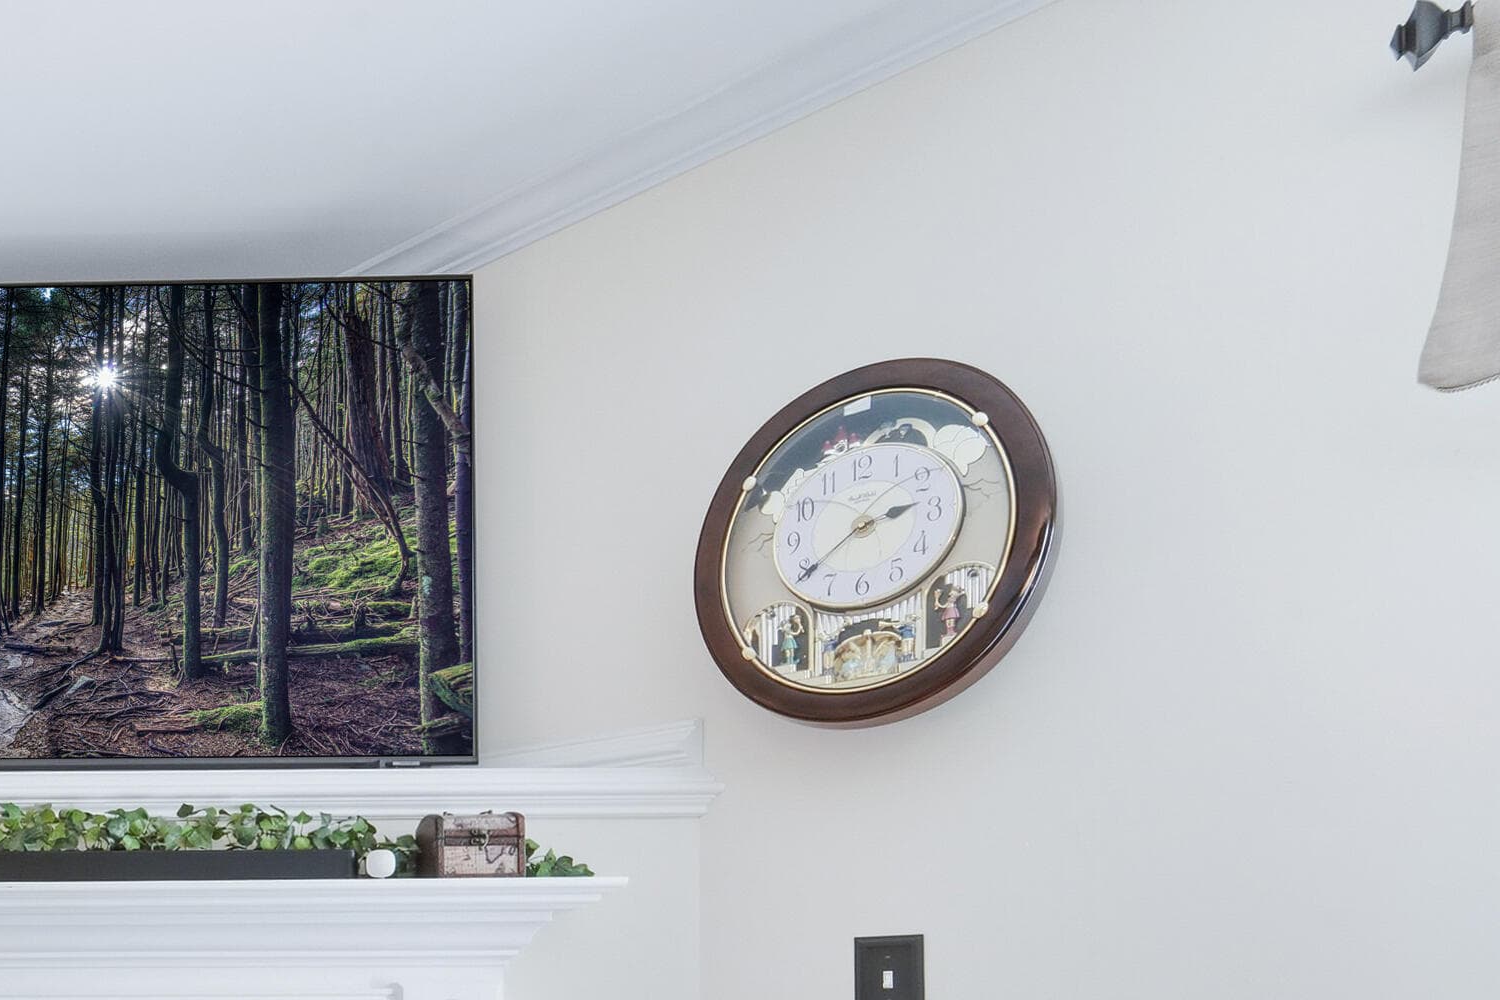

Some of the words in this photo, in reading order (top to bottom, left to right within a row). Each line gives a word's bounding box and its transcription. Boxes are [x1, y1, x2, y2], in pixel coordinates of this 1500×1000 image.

[852, 454, 873, 482] 12
[892, 454, 900, 478] 1
[822, 471, 837, 496] 11
[914, 466, 931, 493] 2
[796, 497, 815, 523] 10
[926, 496, 942, 522] 3
[787, 531, 802, 554] 9
[913, 530, 930, 556] 4
[798, 557, 813, 582] 8
[889, 558, 904, 582] 5
[823, 573, 838, 596] 7
[855, 572, 870, 596] 6
